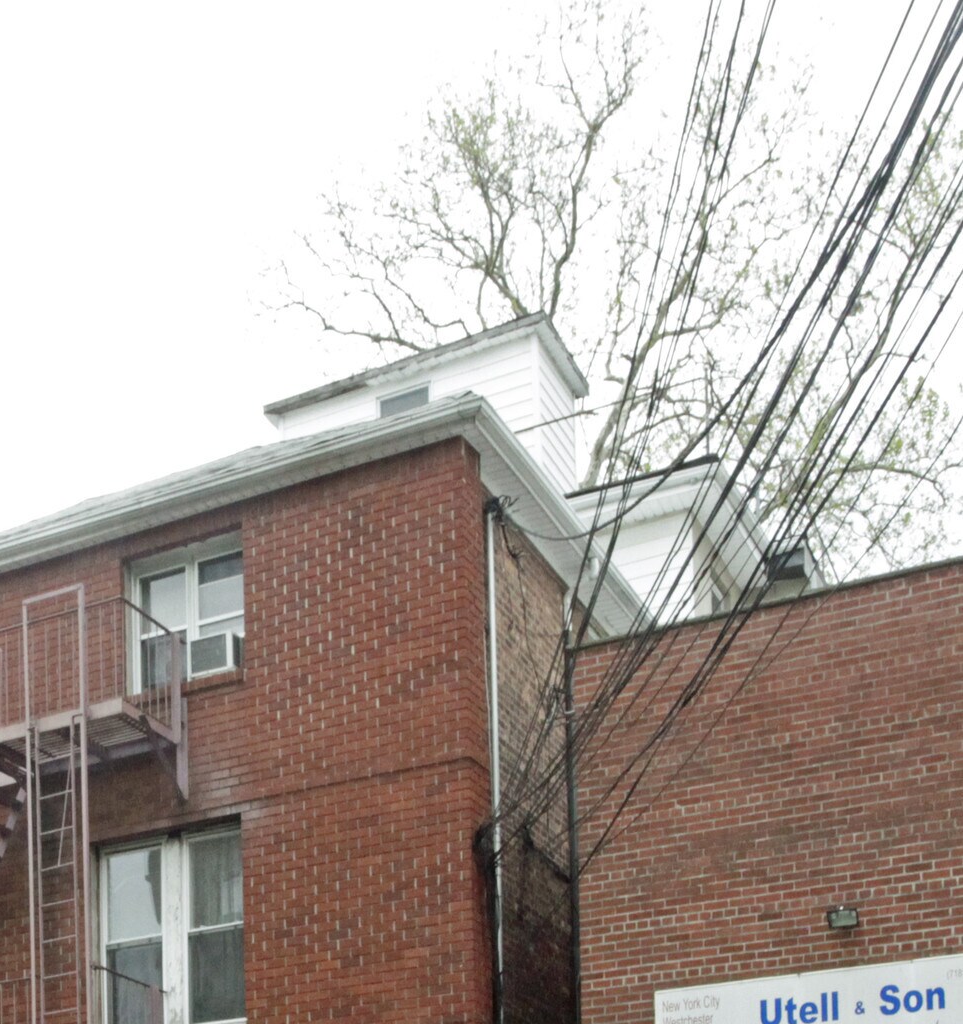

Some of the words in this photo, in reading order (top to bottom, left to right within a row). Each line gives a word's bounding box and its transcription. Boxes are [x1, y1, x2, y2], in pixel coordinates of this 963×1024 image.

[662, 1000, 680, 1013] New
[683, 997, 701, 1010] York
[703, 994, 720, 1009] City
[854, 1001, 865, 1015] &
[879, 984, 946, 1016] Son
